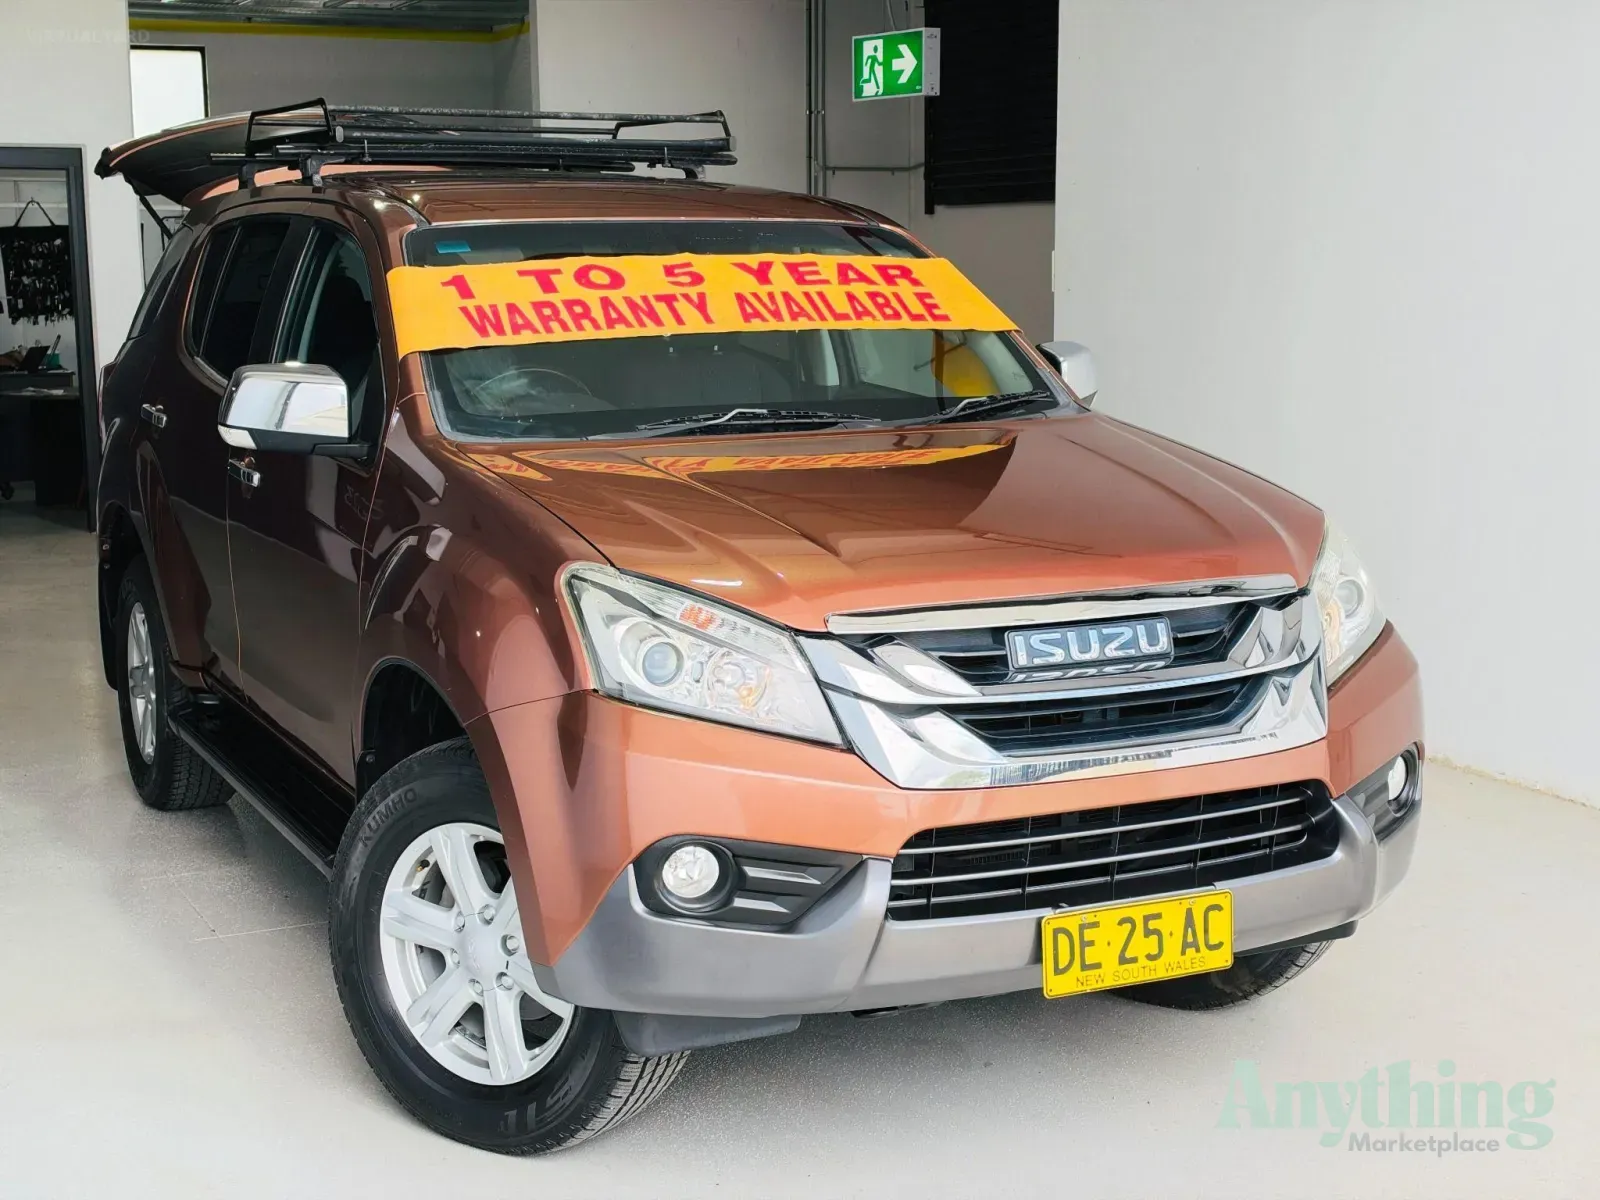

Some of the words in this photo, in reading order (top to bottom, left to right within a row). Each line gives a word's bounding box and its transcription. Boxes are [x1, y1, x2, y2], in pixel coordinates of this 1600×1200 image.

[440, 274, 476, 299] 1
[518, 264, 627, 294] TO
[665, 262, 706, 286] 5
[729, 260, 926, 287] YEAR
[459, 292, 715, 338] WARRANTY
[734, 291, 951, 324] AVAILABLE
[1014, 622, 1169, 666] ISUZU
[358, 788, 418, 848] KUMHO
[1052, 920, 1102, 977] DE
[1117, 912, 1164, 966] 25
[1180, 903, 1225, 957] AC
[1076, 972, 1106, 989] NEW
[1113, 965, 1157, 983] SOUTH
[1164, 955, 1206, 974] WALES
